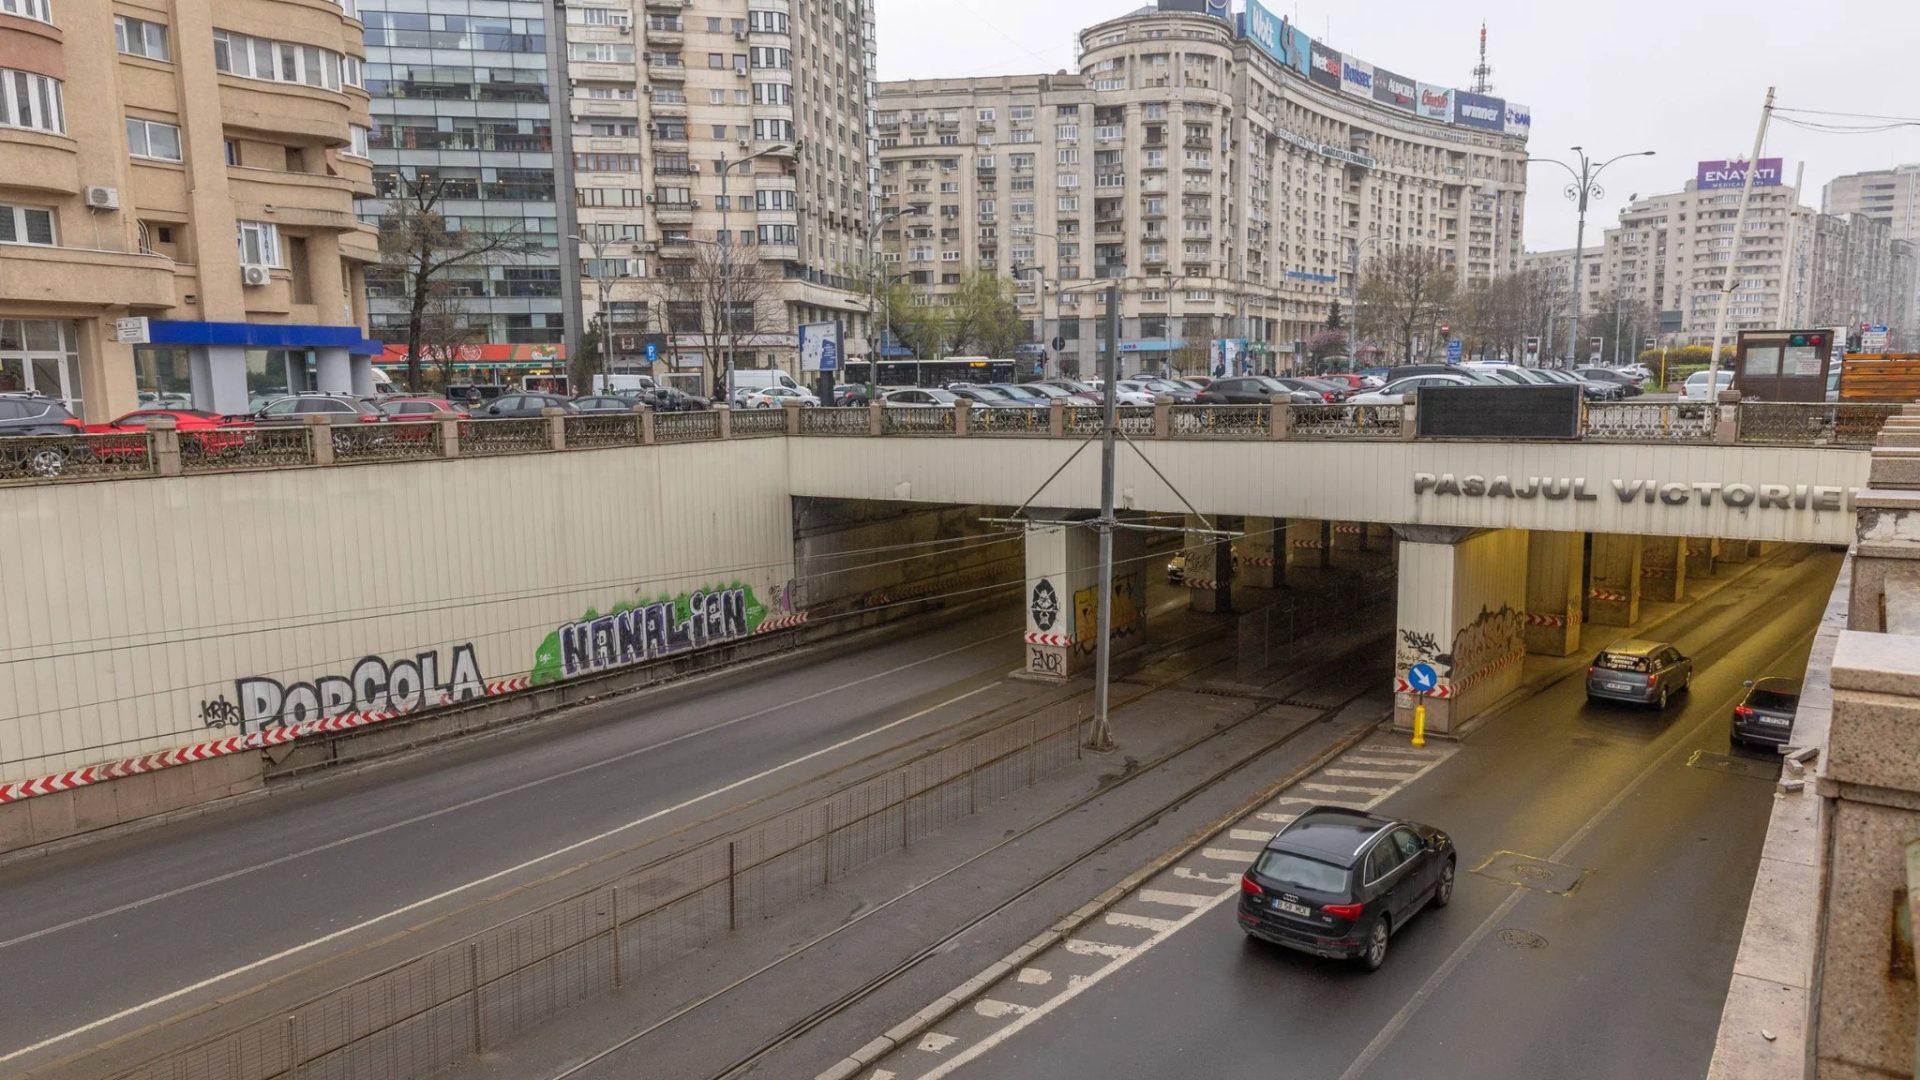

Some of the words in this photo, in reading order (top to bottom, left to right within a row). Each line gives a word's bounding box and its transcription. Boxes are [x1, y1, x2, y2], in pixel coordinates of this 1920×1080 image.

[1252, 6, 1273, 48] Wolt
[1461, 104, 1499, 121] winner
[1414, 472, 1598, 501] PASAJUL
